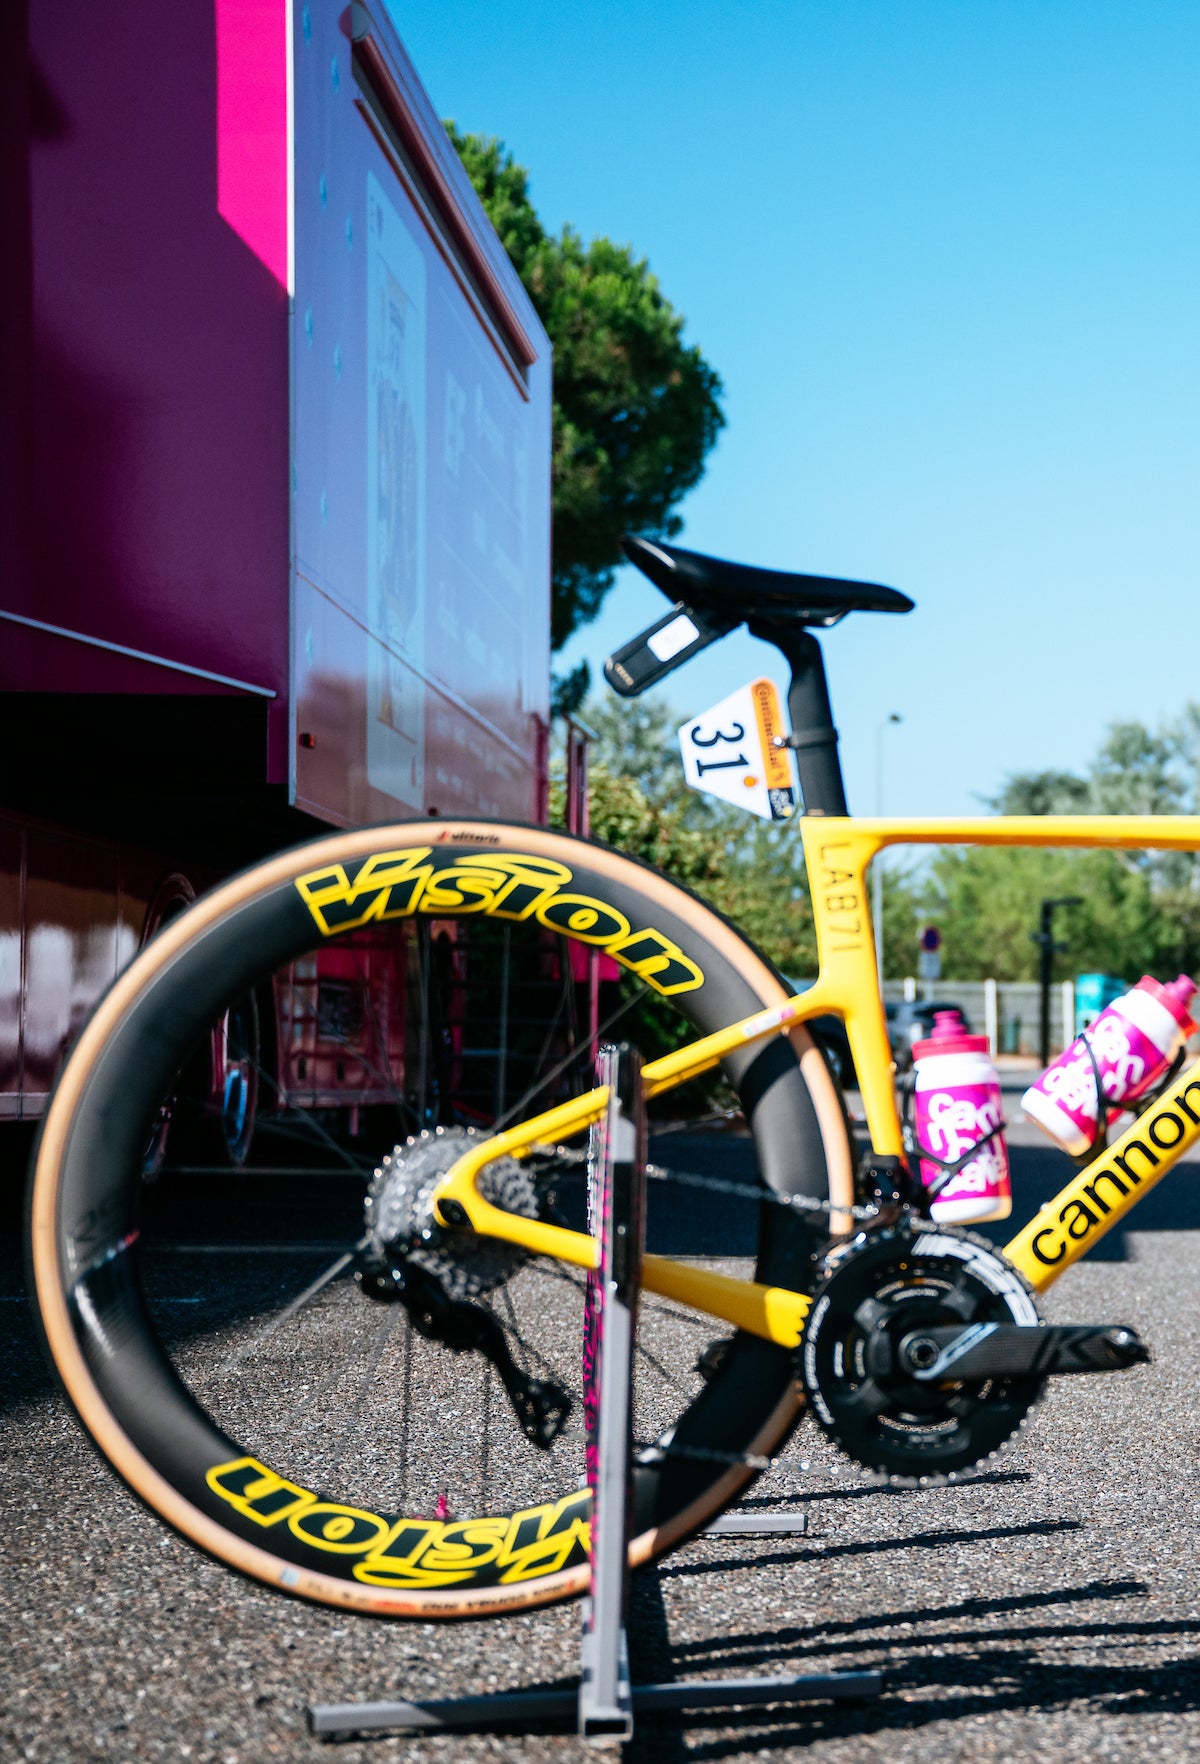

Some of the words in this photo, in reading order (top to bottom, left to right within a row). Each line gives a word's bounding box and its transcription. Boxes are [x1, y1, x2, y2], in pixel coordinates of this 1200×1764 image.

[691, 722, 750, 777] 31
[295, 846, 705, 996] Vision
[820, 842, 863, 953] LAB71
